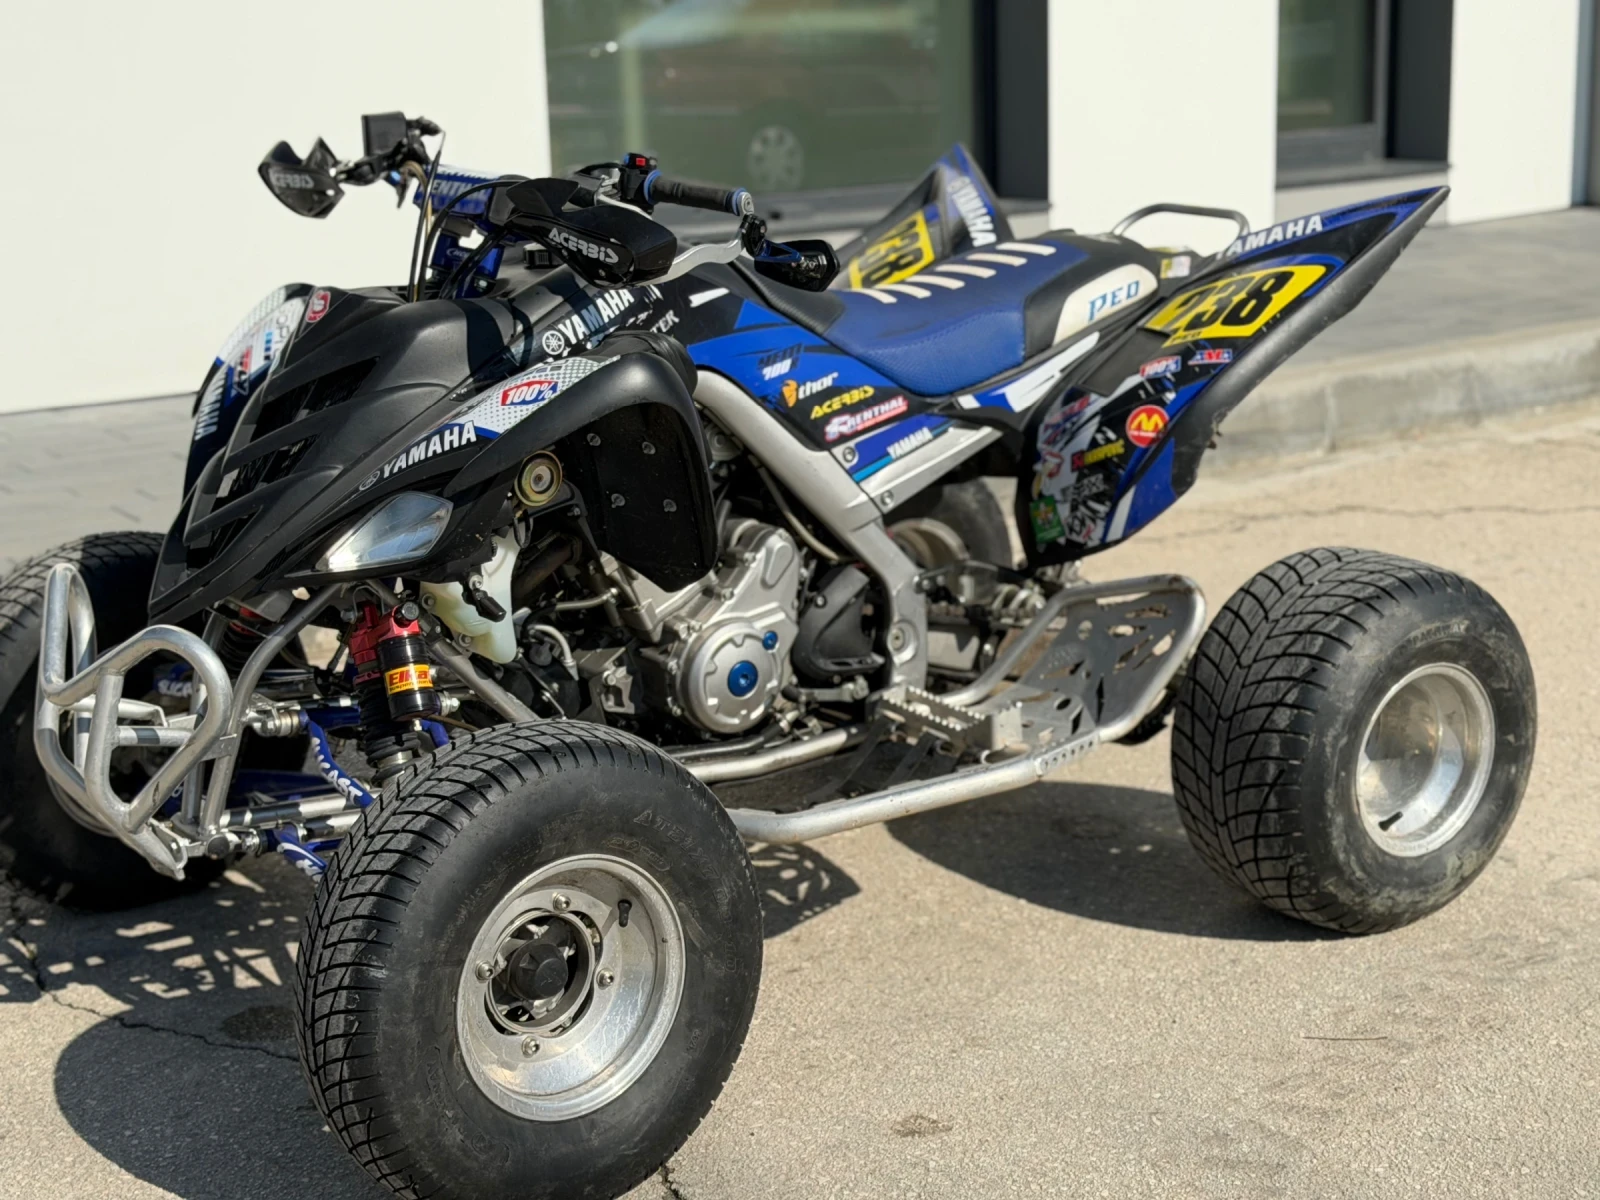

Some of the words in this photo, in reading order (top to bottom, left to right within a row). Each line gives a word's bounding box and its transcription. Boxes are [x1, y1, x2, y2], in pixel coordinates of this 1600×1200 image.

[548, 227, 620, 264] ACERBIS
[558, 288, 635, 346] YAMAHA
[506, 382, 554, 407] 100%
[798, 371, 840, 400] thor
[810, 385, 876, 420] ACERBIS
[382, 420, 478, 479] YAMAHA
[886, 426, 933, 460] YAMAHA
